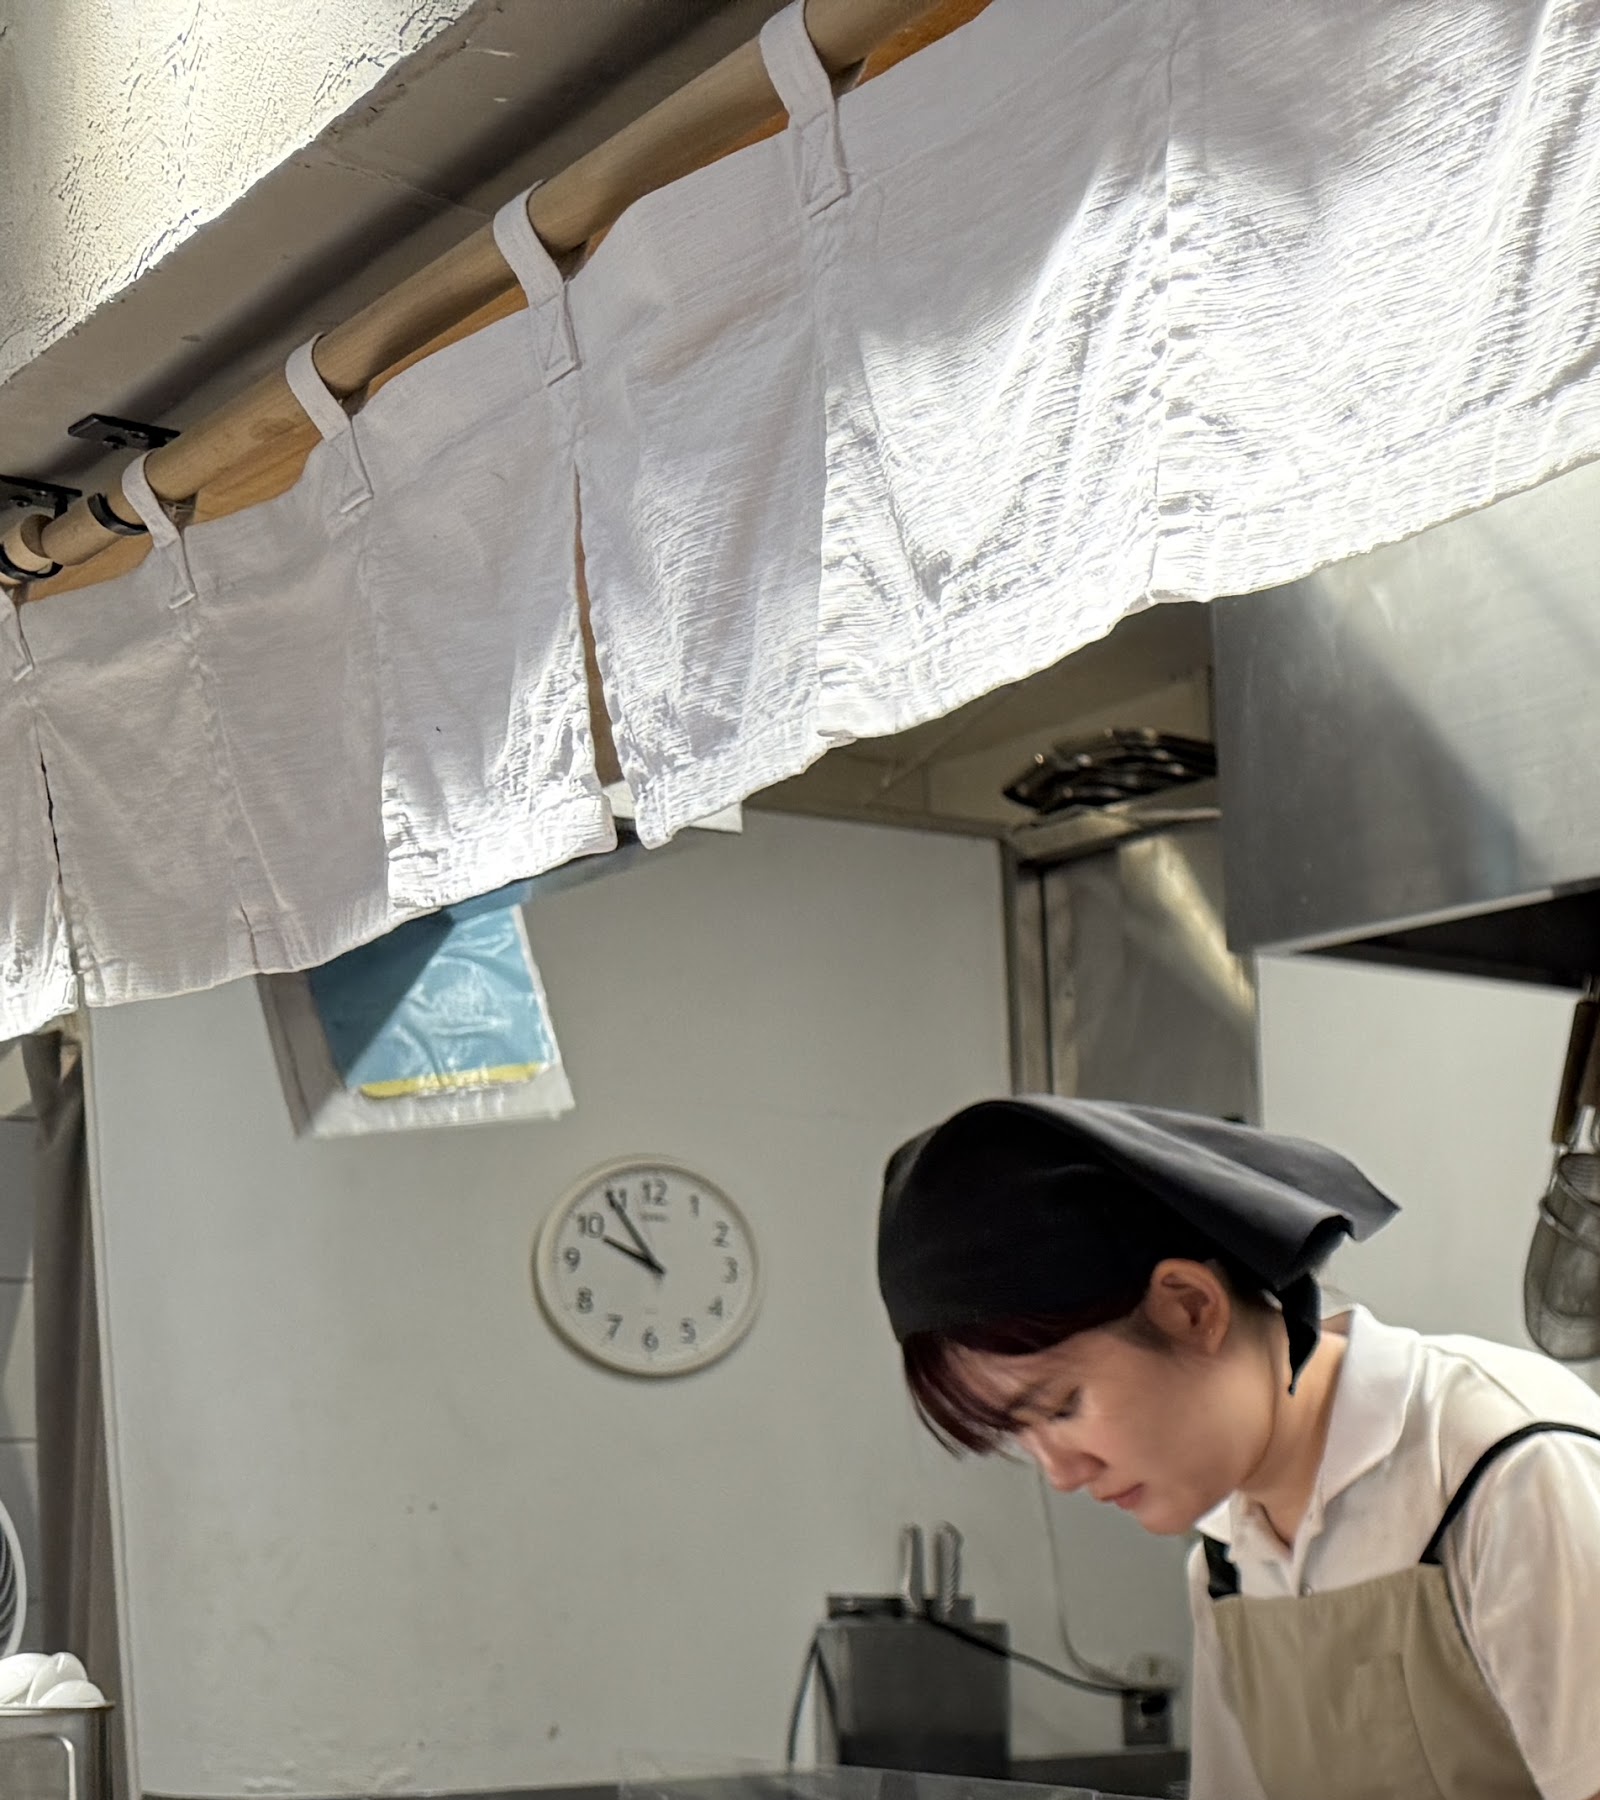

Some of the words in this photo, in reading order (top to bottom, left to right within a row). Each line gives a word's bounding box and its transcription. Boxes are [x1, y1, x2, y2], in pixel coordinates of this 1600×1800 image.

[641, 1178, 668, 1206] 12
[690, 1194, 700, 1217] 1
[577, 1212, 605, 1239] 10
[712, 1220, 729, 1248] 2
[564, 1246, 581, 1272] 9
[723, 1255, 739, 1284] 3
[576, 1287, 594, 1314] 8
[708, 1297, 723, 1318] 4
[607, 1313, 624, 1340] 7
[642, 1327, 659, 1352] 6
[680, 1317, 696, 1344] 5
